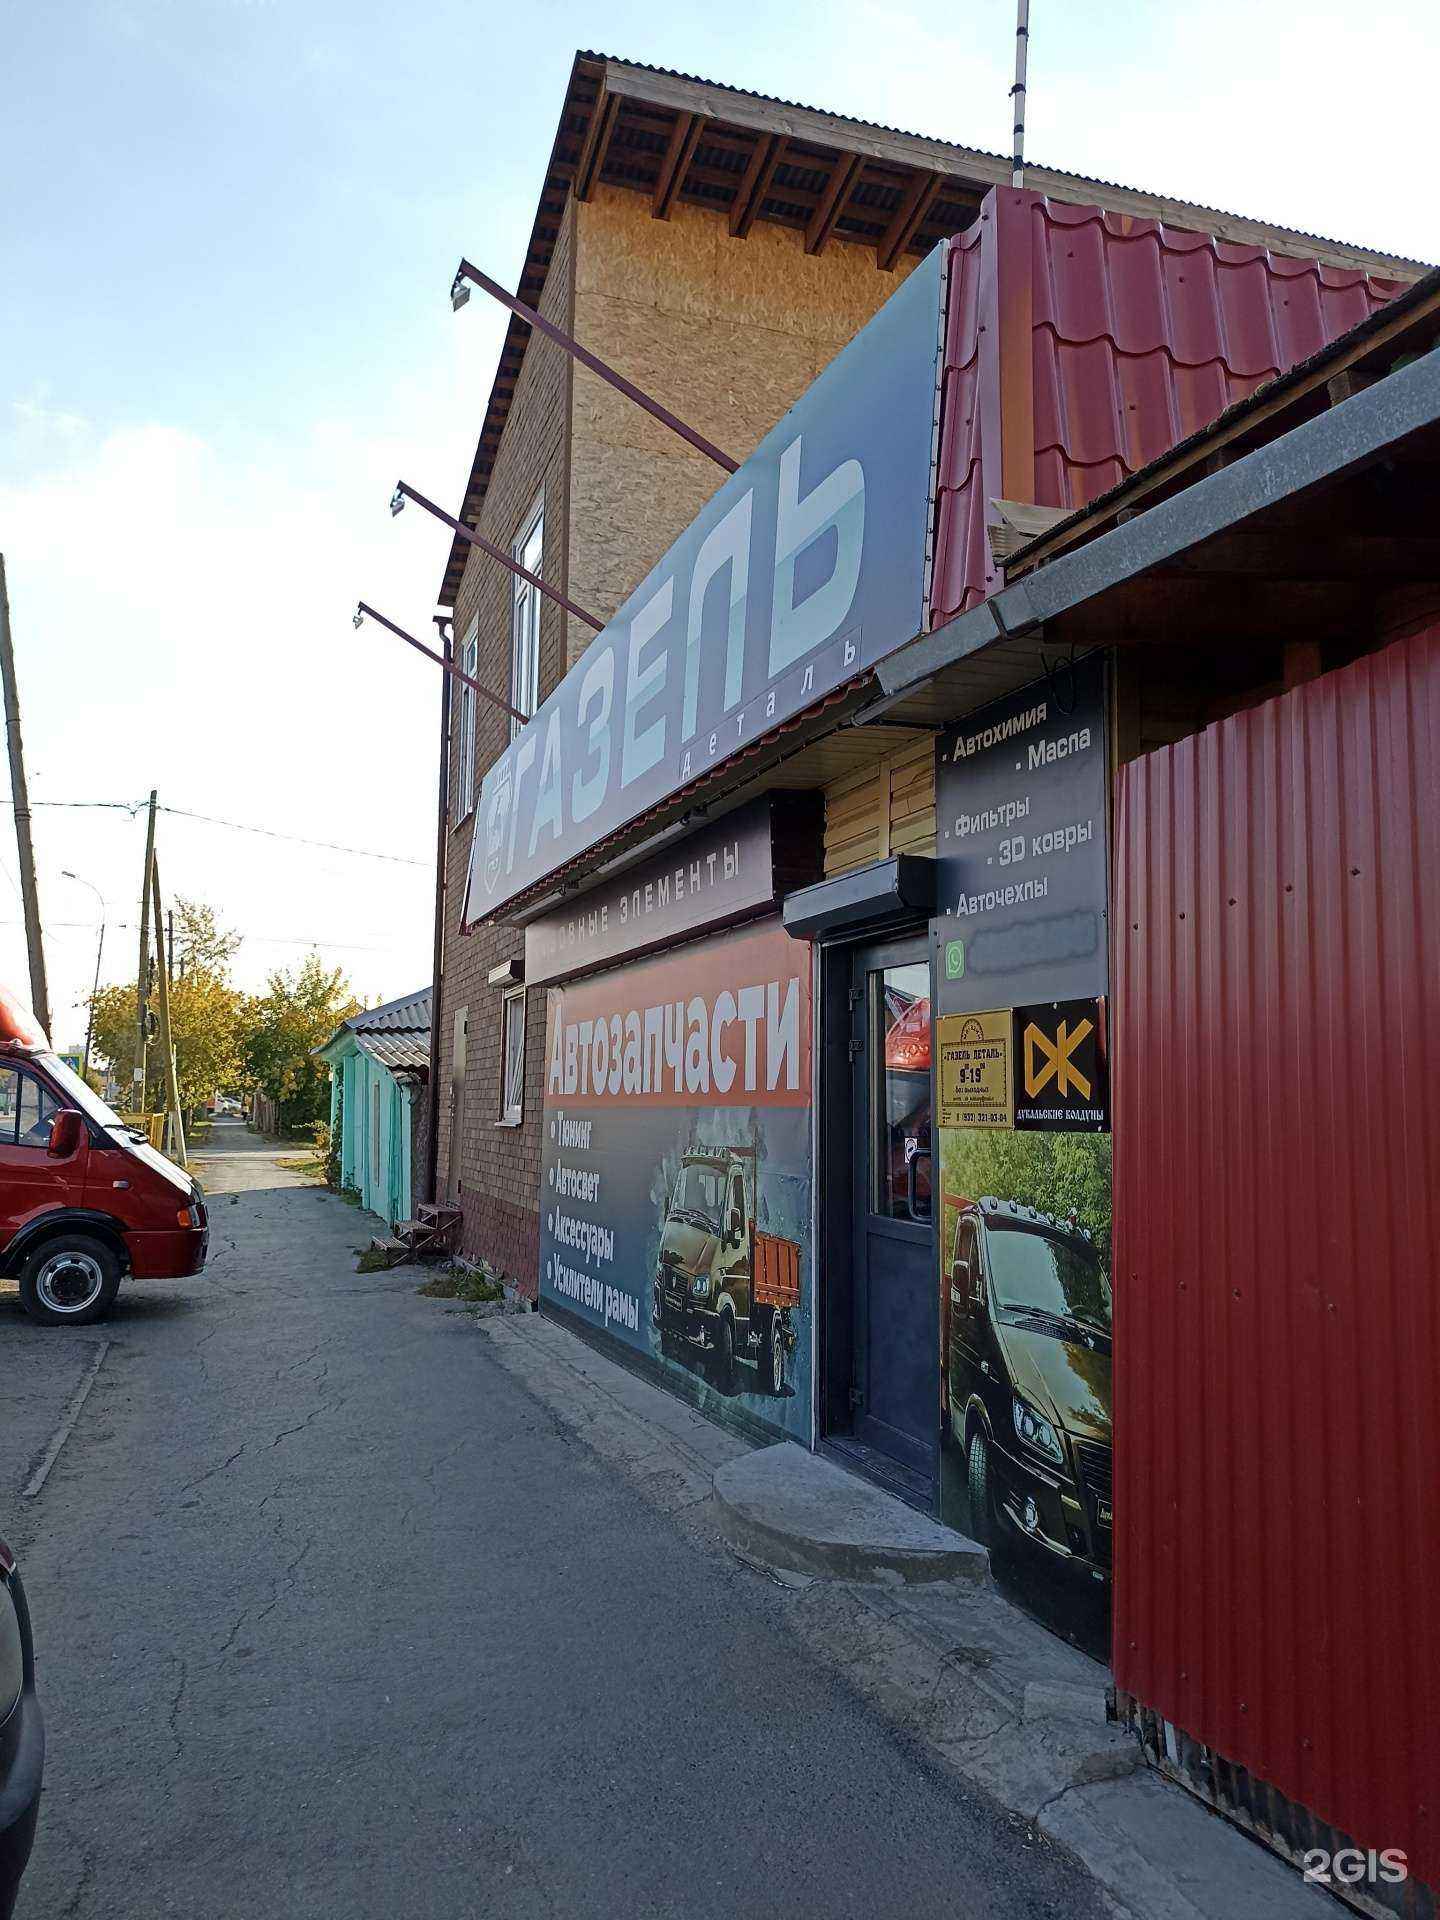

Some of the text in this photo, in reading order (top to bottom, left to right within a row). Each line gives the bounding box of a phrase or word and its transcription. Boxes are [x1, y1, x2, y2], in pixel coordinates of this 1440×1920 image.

[504, 434, 866, 876] ГАЗЕЛЬ
[953, 702, 1048, 762] Автохимия
[1028, 727, 1091, 770] Масла
[955, 796, 1030, 838] Фильтры
[999, 820, 1092, 866] 3D ковры
[619, 841, 740, 924] ЭЛЕМЕНТЫ
[956, 877, 1048, 918] Авточехлы
[548, 977, 800, 1096] Автозапчасти
[557, 1111, 592, 1150] Тюнинг
[555, 1158, 600, 1203] Автосвет
[553, 1206, 614, 1268] Аксессуары
[552, 1253, 639, 1332] Усилители рамы
